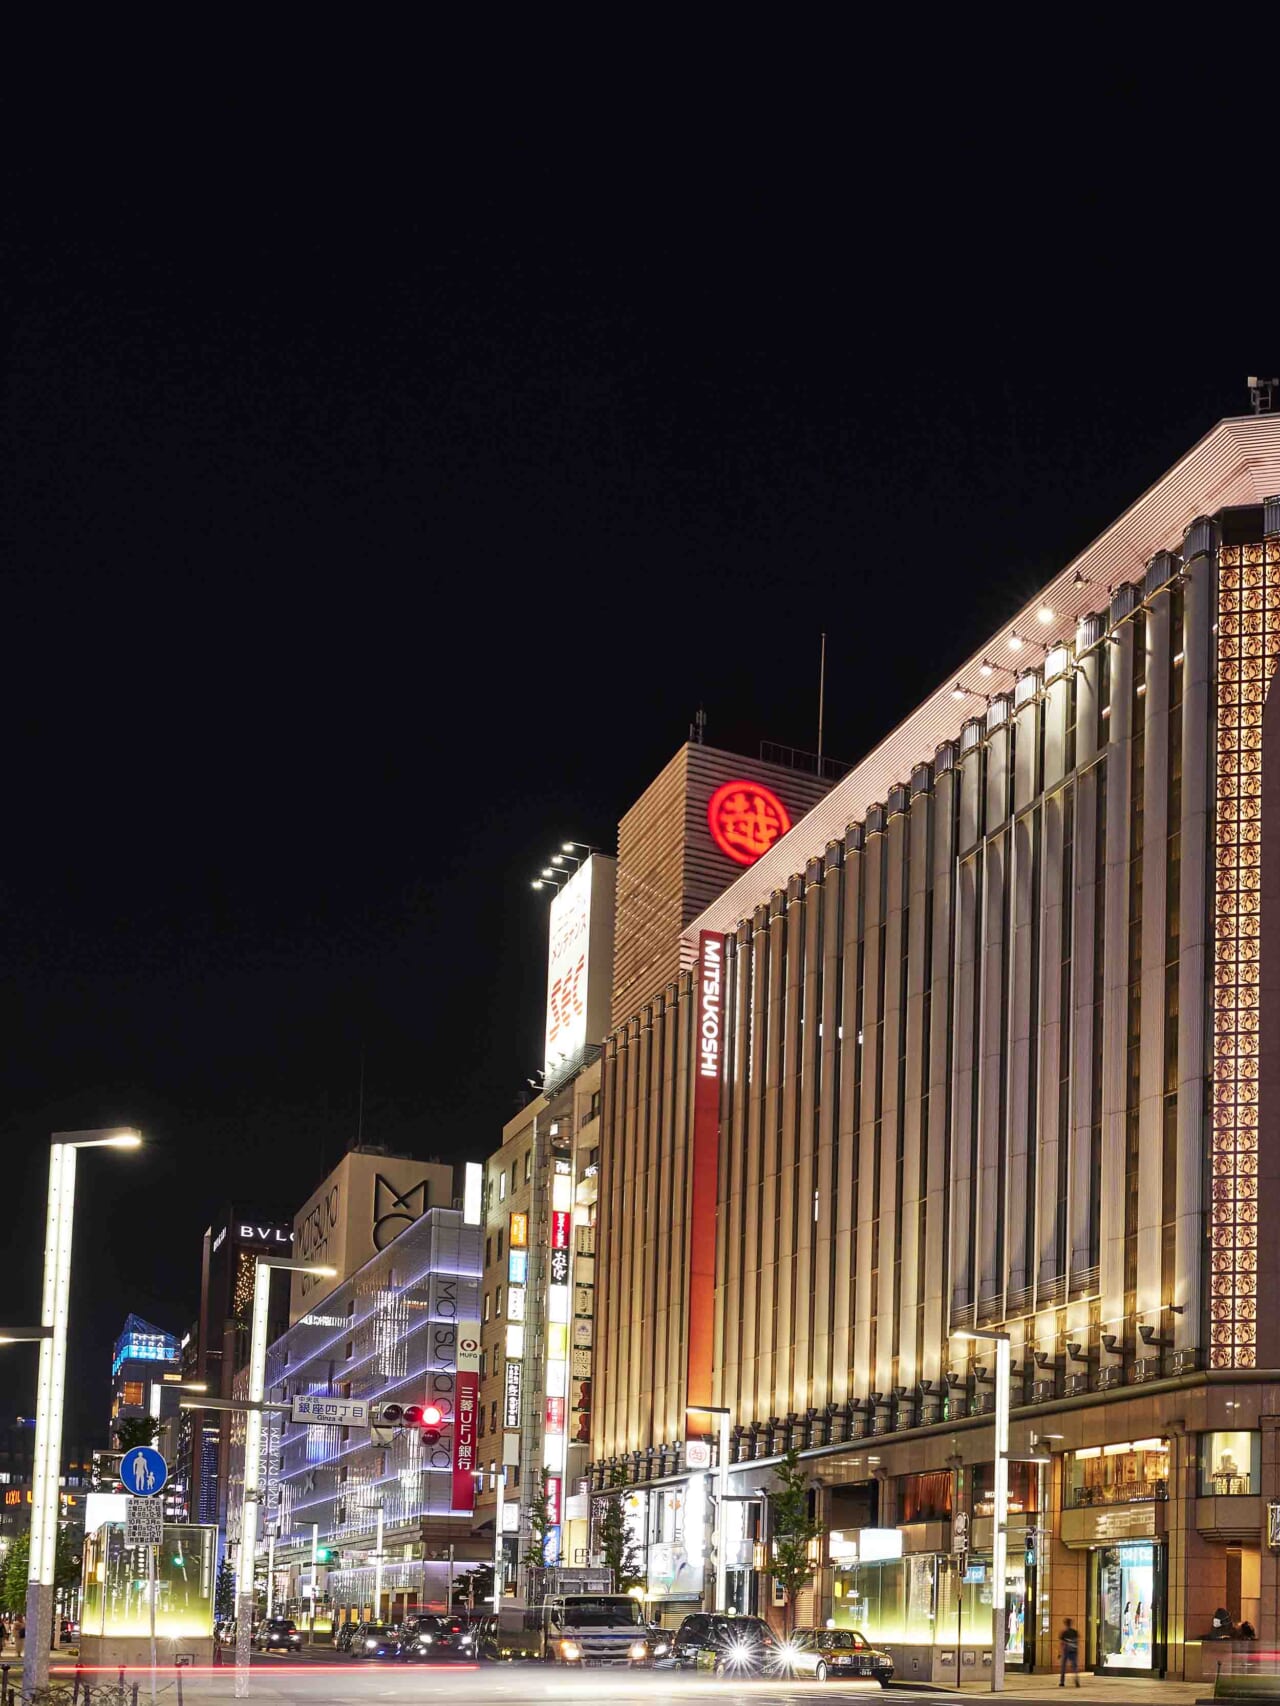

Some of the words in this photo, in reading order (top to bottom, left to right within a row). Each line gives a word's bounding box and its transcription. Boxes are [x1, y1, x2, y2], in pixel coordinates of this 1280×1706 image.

[700, 939, 721, 1077] MITSUKOSHI
[459, 1351, 478, 1359] MUFG
[298, 1402, 363, 1418] 銀座四丁目
[317, 1414, 336, 1423] Ginza
[458, 1386, 475, 1470] 三菱UFJ銀行
